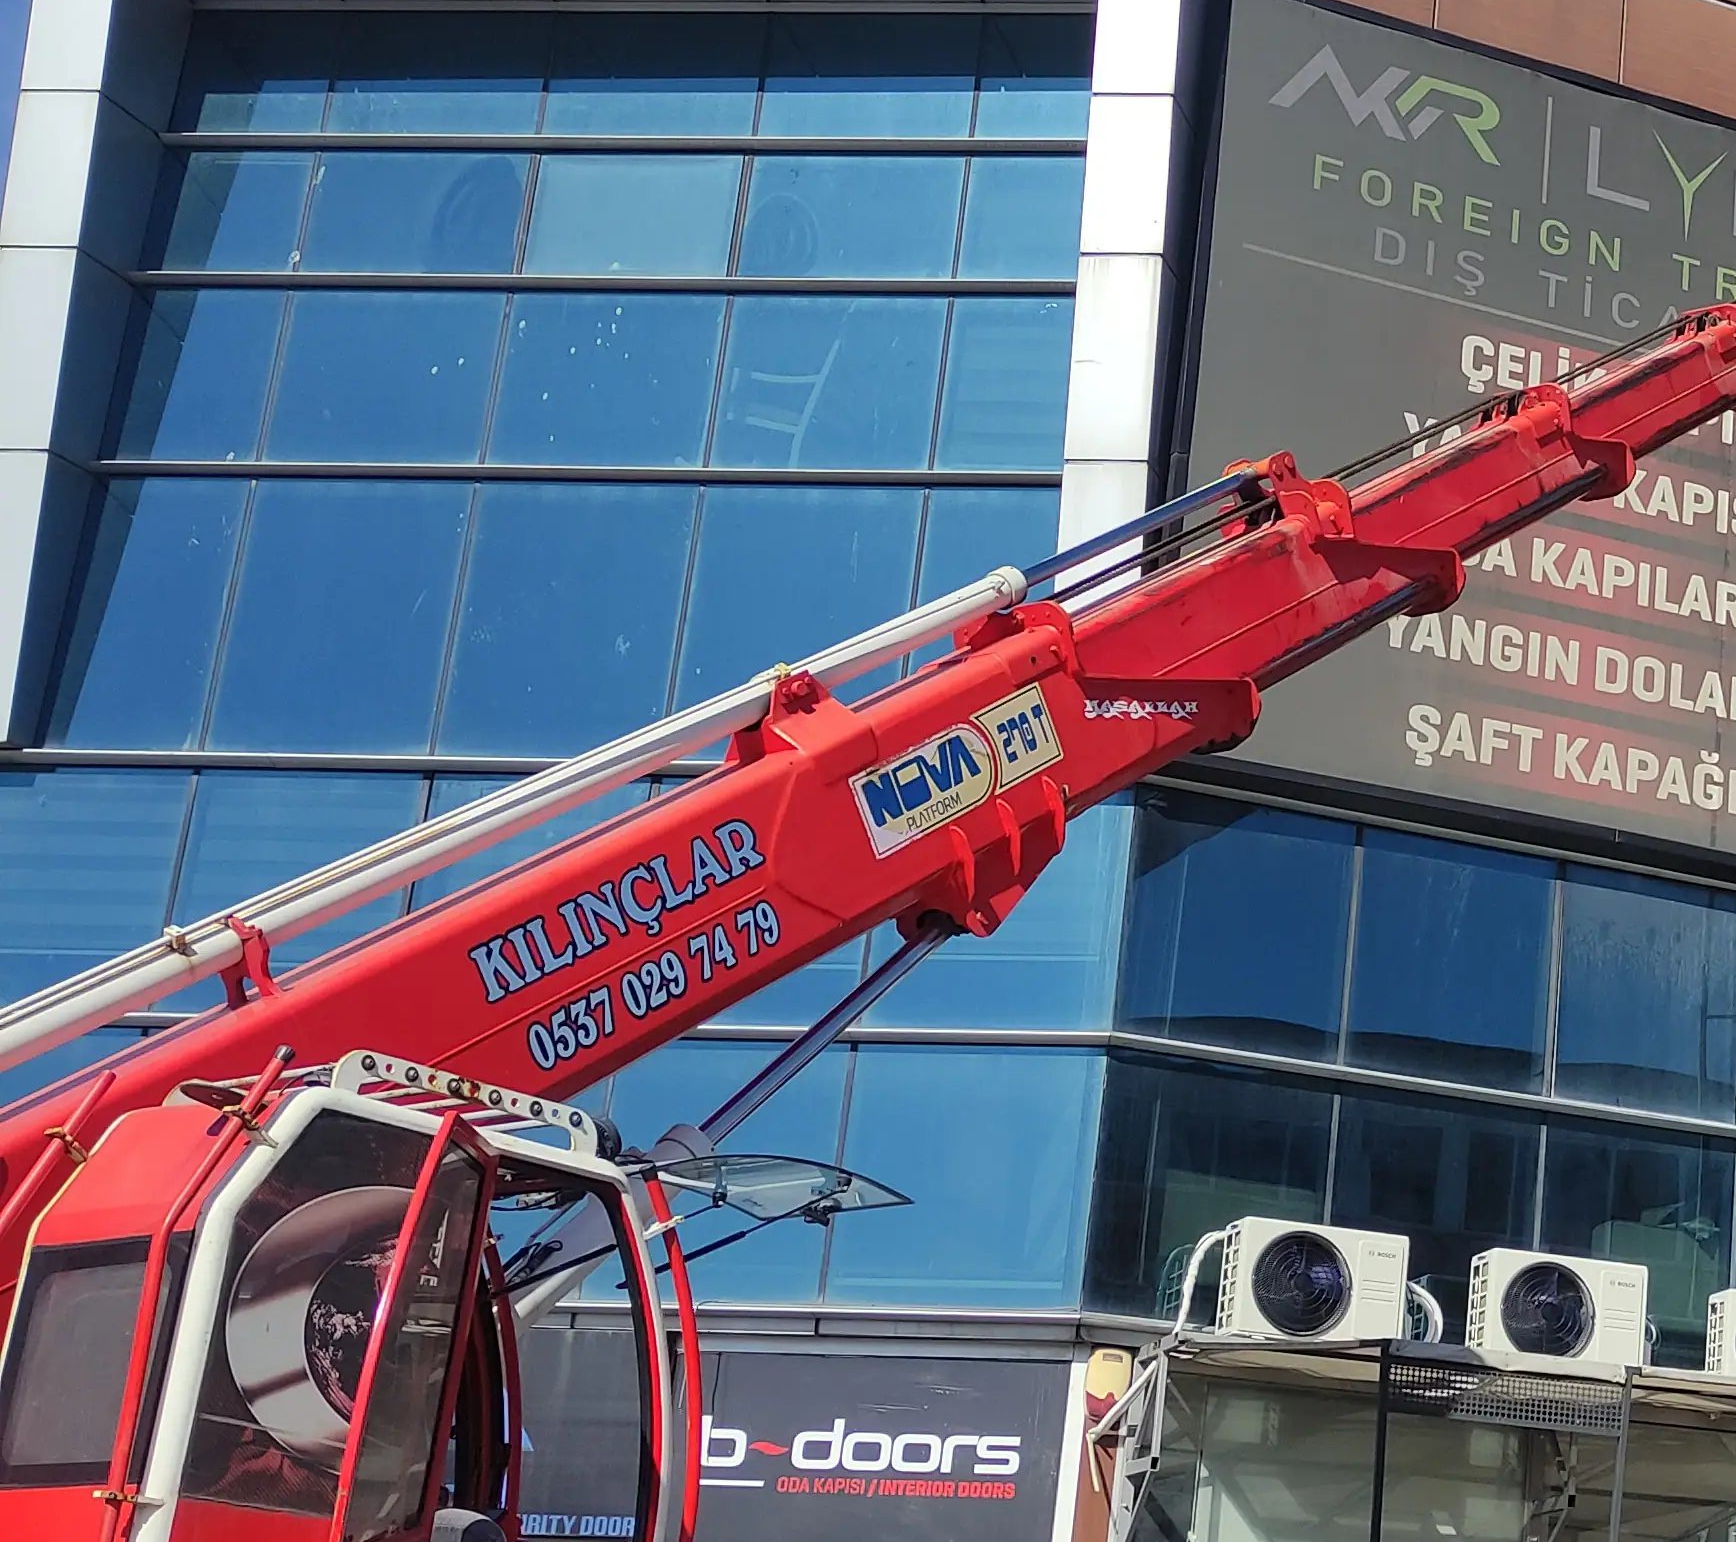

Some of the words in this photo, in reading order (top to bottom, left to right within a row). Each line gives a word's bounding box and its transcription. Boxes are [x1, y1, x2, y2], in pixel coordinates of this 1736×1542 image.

[1313, 154, 1621, 271] FOREIGN
[1373, 226, 1485, 296] DIŞ
[1386, 613, 1580, 686] YANGIN
[1405, 703, 1543, 773] ŞAFT
[861, 735, 982, 828] NOVA
[906, 791, 962, 833] PLATFORM
[468, 819, 766, 1003] KILINÇLAR
[528, 985, 615, 1071] 0537
[621, 951, 687, 1017] 029
[689, 925, 737, 981] 74
[736, 901, 780, 955] 79
[776, 1475, 810, 1495] ODA
[813, 1477, 865, 1496] KAPISI
[879, 1479, 954, 1499] INTERIOR
[957, 1480, 1016, 1500] DOORS
